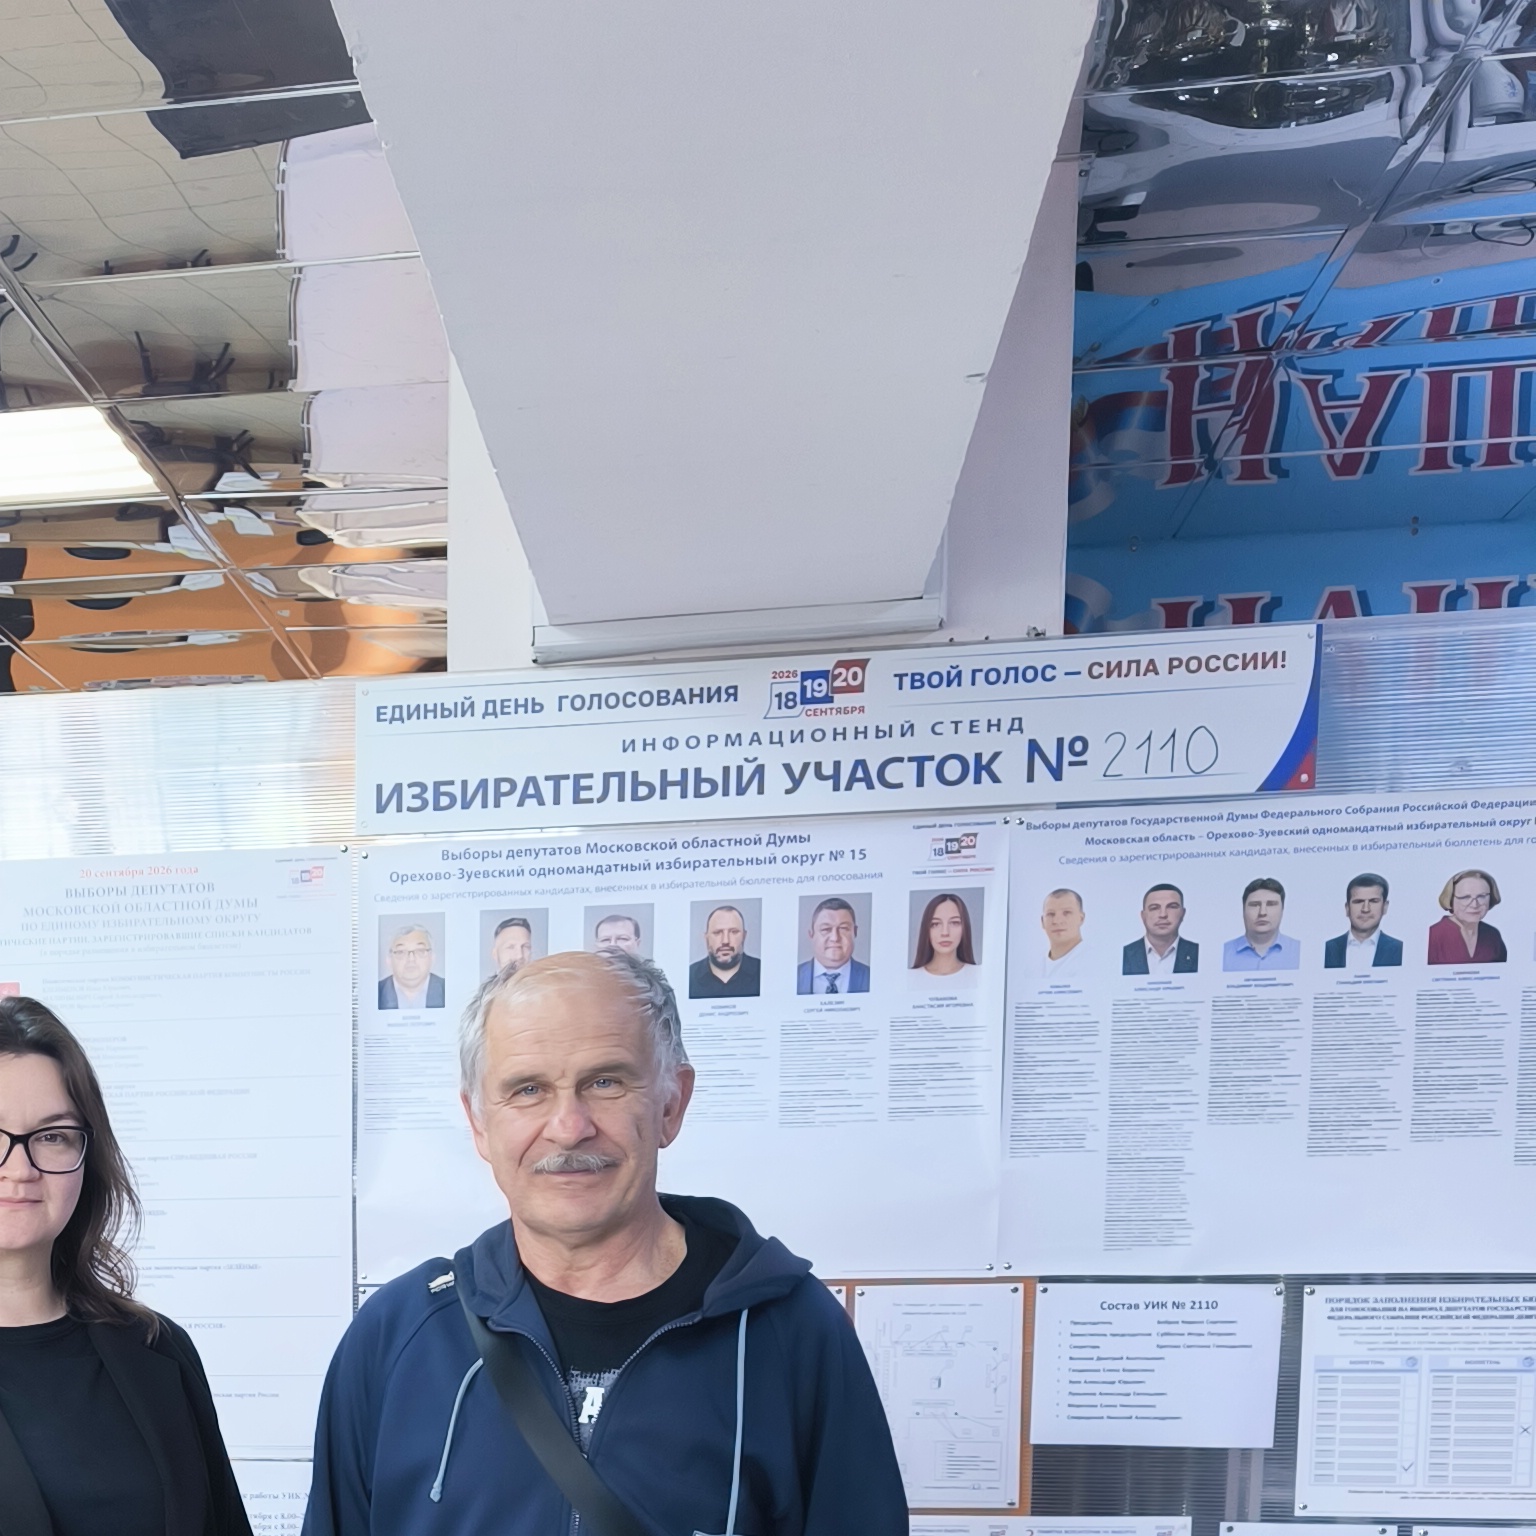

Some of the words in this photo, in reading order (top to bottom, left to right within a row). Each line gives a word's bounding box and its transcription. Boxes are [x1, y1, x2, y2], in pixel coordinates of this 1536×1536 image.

[771, 669, 798, 680] 2026
[894, 664, 963, 691] ТВОЙ
[970, 664, 1057, 687] ГОЛОС
[1087, 654, 1160, 680] СИЛА
[1167, 650, 1287, 675] РОССИИ!
[774, 691, 797, 710] 18
[803, 679, 827, 699] 19
[832, 667, 863, 687] 20
[375, 698, 476, 724] ЕДИНЫЙ
[481, 697, 545, 720] ДЕНЬ
[557, 685, 739, 713] ГОЛОСОВАНИЯ
[805, 704, 865, 718] СЕНТЯБРЯ
[622, 720, 915, 754] ИНФОРМАЦИОННЫЙ
[931, 716, 1024, 737] СТЕНД
[1102, 725, 1219, 778] 2110
[375, 757, 765, 814] ИЗБИРАТЕЛЬНЫЙ
[782, 750, 1003, 796] УЧАСТОК
[1026, 735, 1089, 784] №
[1026, 820, 1070, 831] Выборы
[1073, 817, 1127, 830] депутатов
[1131, 812, 1223, 827] Государственной
[1226, 810, 1258, 822] Думы
[1260, 805, 1342, 819] Федерального
[1345, 803, 1400, 816] Собрания
[1403, 800, 1468, 812] Российской
[933, 848, 944, 856] 18
[946, 842, 958, 851] 19
[960, 836, 975, 846] 20
[1085, 834, 1150, 846] Московская
[1152, 832, 1195, 843] область
[1206, 826, 1309, 842] Орехово-Зуевский
[1312, 821, 1403, 836] одномандатный
[1406, 817, 1496, 831] избирательный
[1499, 817, 1532, 828] округ
[441, 849, 502, 862] Выборы
[506, 844, 581, 860] депутатов
[586, 838, 678, 855] Московской
[681, 834, 762, 849] областной
[766, 834, 811, 848] Думы
[1059, 855, 1107, 866] Сведения
[1110, 855, 1116, 863] о
[1119, 849, 1226, 864] зарегистрированных
[1293, 843, 1350, 854] внесенных
[1361, 838, 1442, 851] избирательный
[1444, 837, 1502, 847] бюллетень
[1504, 836, 1524, 846] для
[80, 868, 92, 879] 20
[94, 866, 145, 880] сентября
[147, 866, 173, 876] 2026
[175, 865, 199, 877] года
[390, 866, 525, 885] Орехово-Зуевский
[529, 859, 651, 878] одномандатный
[655, 853, 777, 872] избирательный
[781, 852, 824, 868] округ
[829, 850, 844, 861] №
[850, 849, 867, 861] 15
[65, 885, 127, 899] ВЫБОРЫ
[131, 882, 215, 898] ДЕПУТАТОВ
[374, 892, 419, 903] Сведения
[422, 893, 428, 901] о
[430, 887, 532, 903] зарегистрированных
[595, 881, 648, 893] внесенных
[650, 882, 657, 890] в
[659, 876, 737, 890] избирательный
[740, 874, 794, 887] бюллетень
[796, 873, 815, 884] для
[817, 871, 883, 883] голосования
[21, 921, 37, 932] ПО
[41, 918, 99, 932] ЕДИНОМУ
[102, 915, 211, 930] ИЗБИРАТЕЛЬНОМУ
[215, 912, 261, 926] ОКРУГУ
[24, 901, 120, 918] МОСКОВСКОЙ
[124, 899, 211, 915] ОБЛАСТНОЙ
[214, 898, 258, 912] ДУМЫ
[205, 930, 244, 940] СПИСКИ
[247, 927, 312, 938] КАНДИДАТОВ
[1100, 1300, 1140, 1311] Состав
[1143, 1300, 1168, 1310] УИК
[1171, 1300, 1186, 1310] №
[1189, 1300, 1218, 1310] 2110
